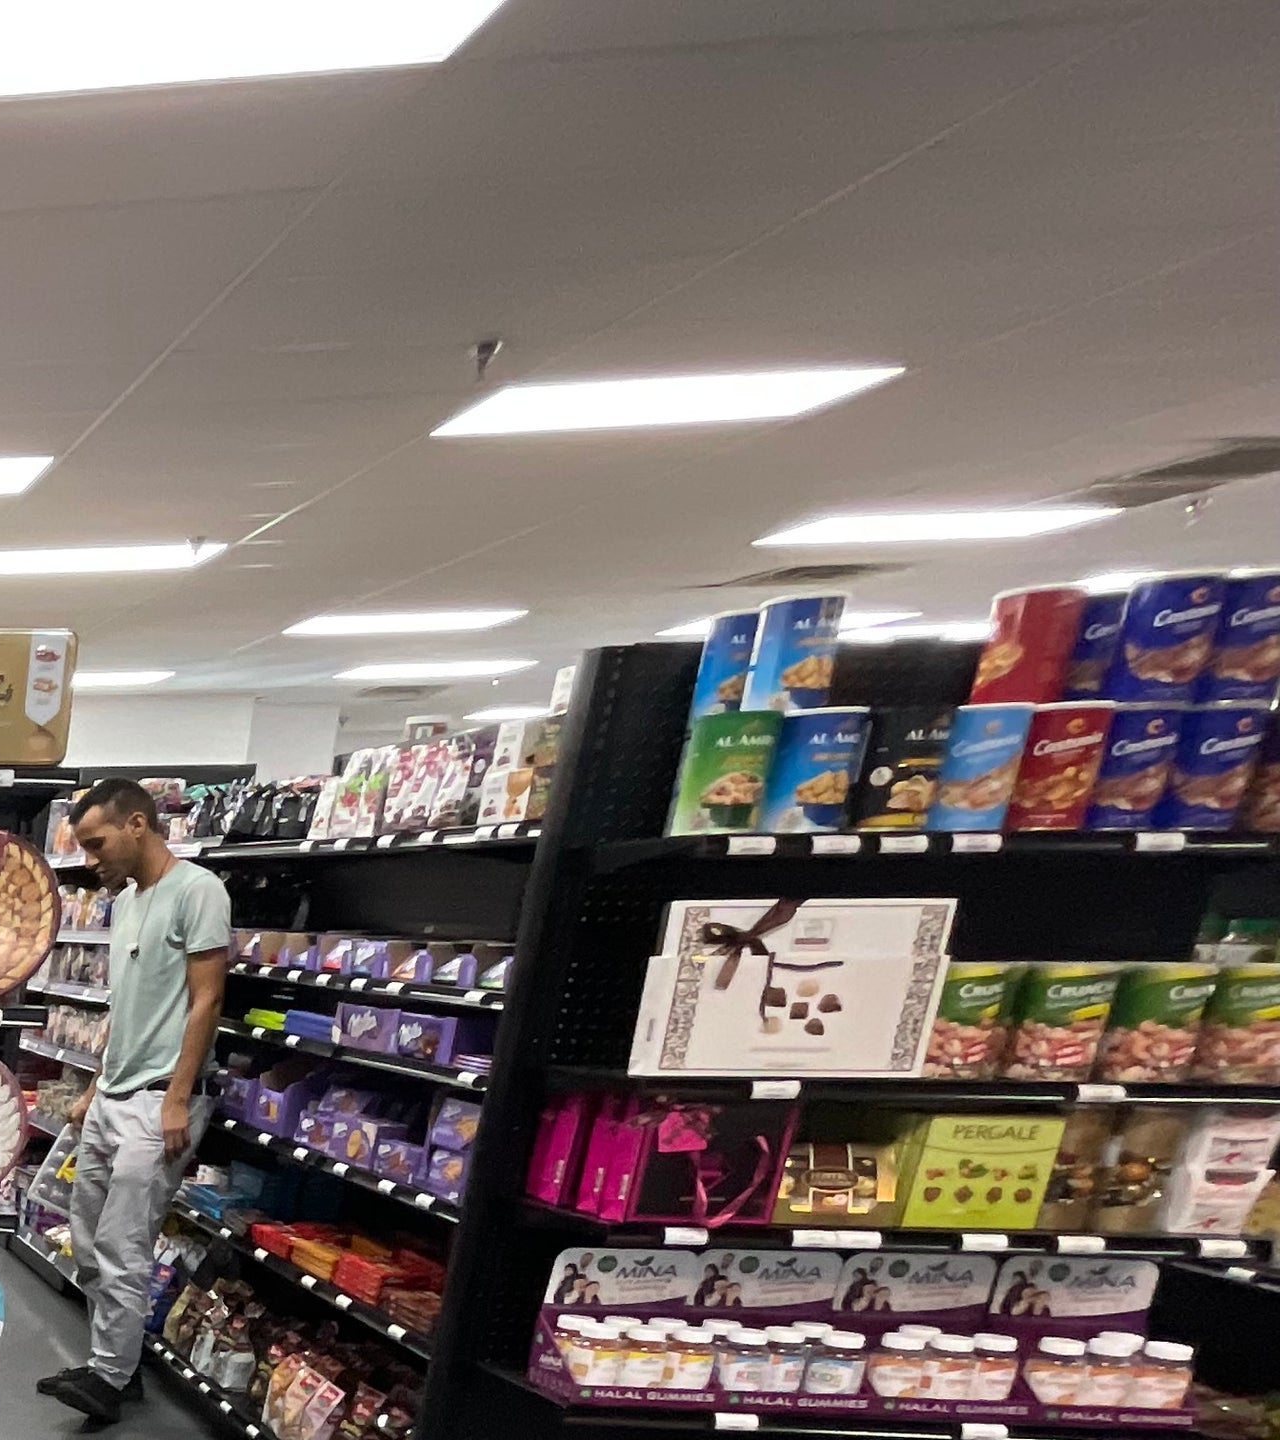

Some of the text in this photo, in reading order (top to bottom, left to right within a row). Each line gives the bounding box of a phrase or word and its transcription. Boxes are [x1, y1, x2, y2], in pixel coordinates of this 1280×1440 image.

[953, 1124, 1040, 1141] PERGALE
[615, 1263, 678, 1279] MINA
[594, 1389, 716, 1403] HALAL GUMMIES
[743, 1394, 868, 1408] HALAL GUMMIES
